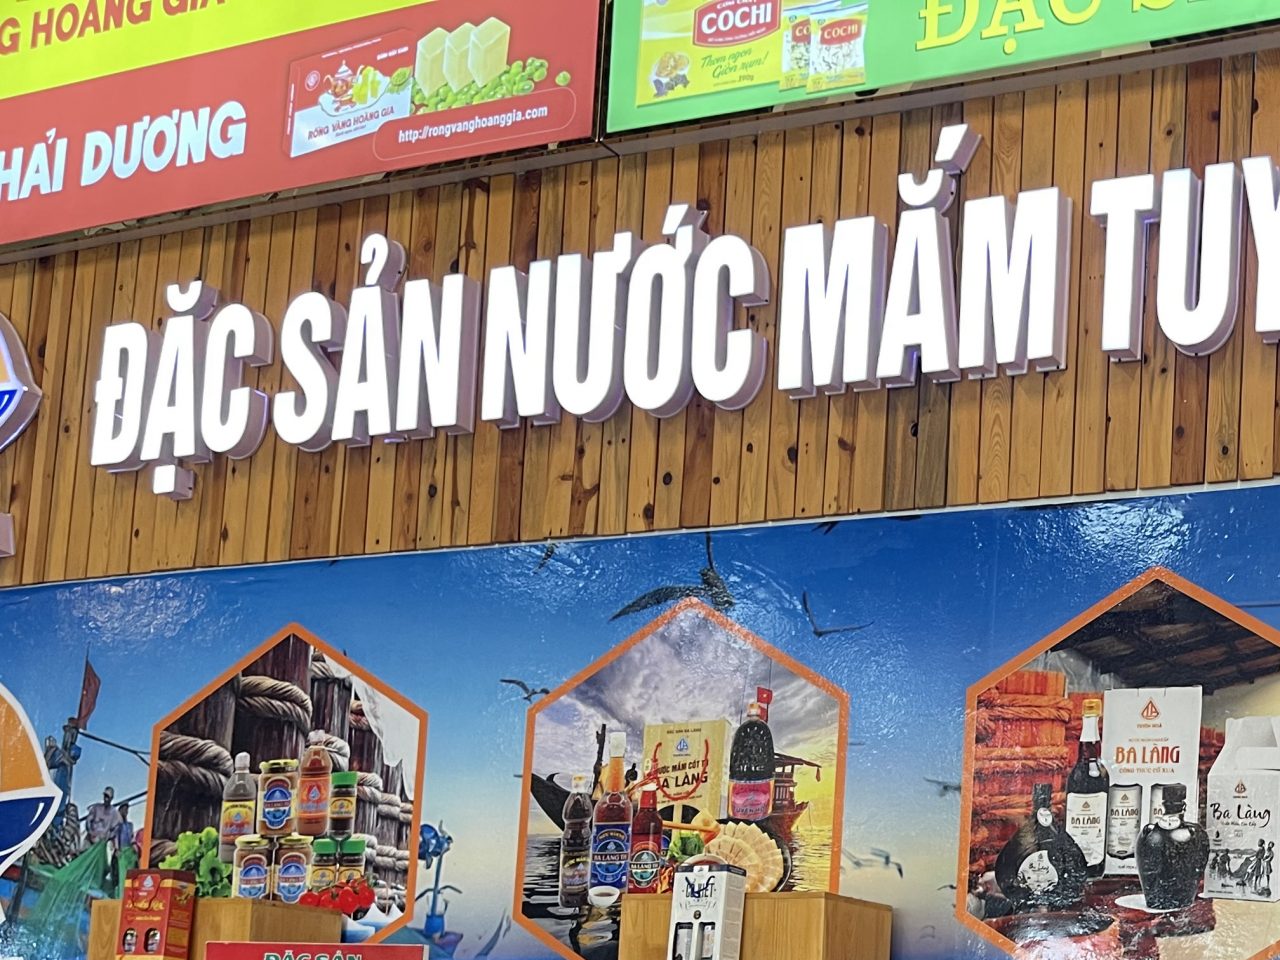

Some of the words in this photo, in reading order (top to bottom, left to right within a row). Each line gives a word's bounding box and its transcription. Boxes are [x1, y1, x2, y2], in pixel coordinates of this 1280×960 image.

[700, 3, 772, 35] COCHI
[823, 24, 859, 40] COCHI
[381, 104, 395, 118] GIA
[397, 104, 549, 144] http://rongvanghoanggia.com
[80, 101, 247, 186] DƯƠNG
[92, 280, 262, 499] ĐẶC
[273, 233, 472, 446] SẢN
[481, 203, 760, 422] NƯỚC
[778, 123, 1062, 391] MẮM
[1115, 746, 1137, 764] BA
[1142, 743, 1180, 764] LÀNG
[1210, 802, 1231, 820] Ba
[1237, 803, 1271, 829] Làng
